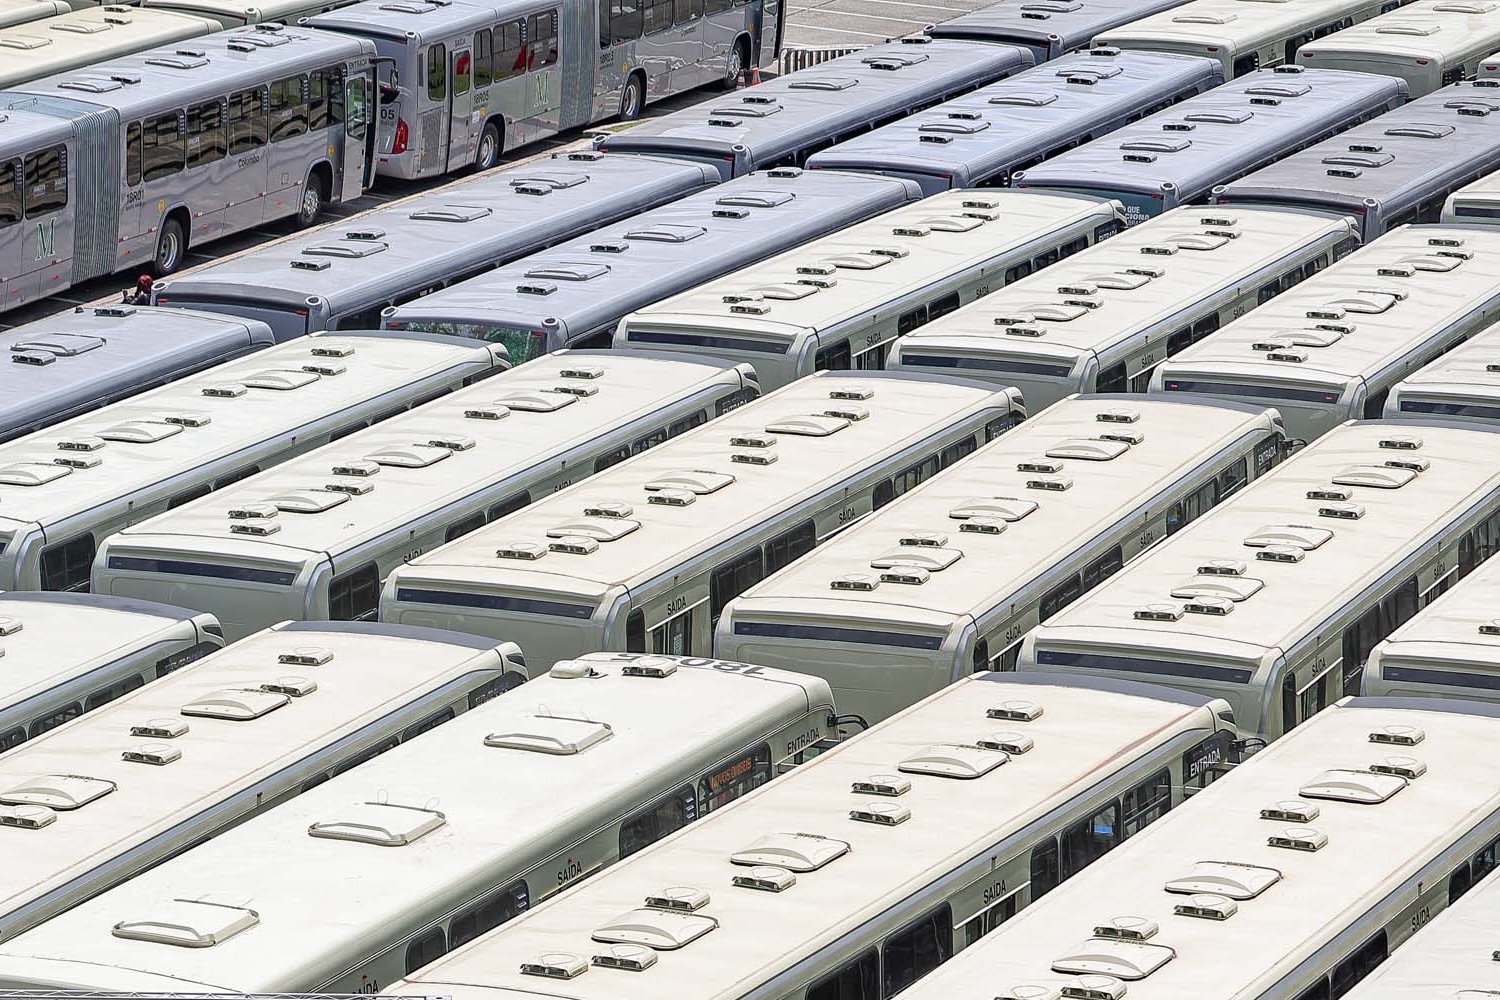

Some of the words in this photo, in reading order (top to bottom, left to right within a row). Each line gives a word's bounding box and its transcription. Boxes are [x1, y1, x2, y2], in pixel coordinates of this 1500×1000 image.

[35, 217, 56, 261] M
[668, 595, 688, 616] SAÍDA
[787, 728, 821, 756] ENTRADA
[1190, 747, 1221, 777] ENTRADA
[557, 861, 582, 886] SAÍDA
[982, 879, 1007, 905] SAÍDA
[1411, 906, 1430, 932] SAÍDA
